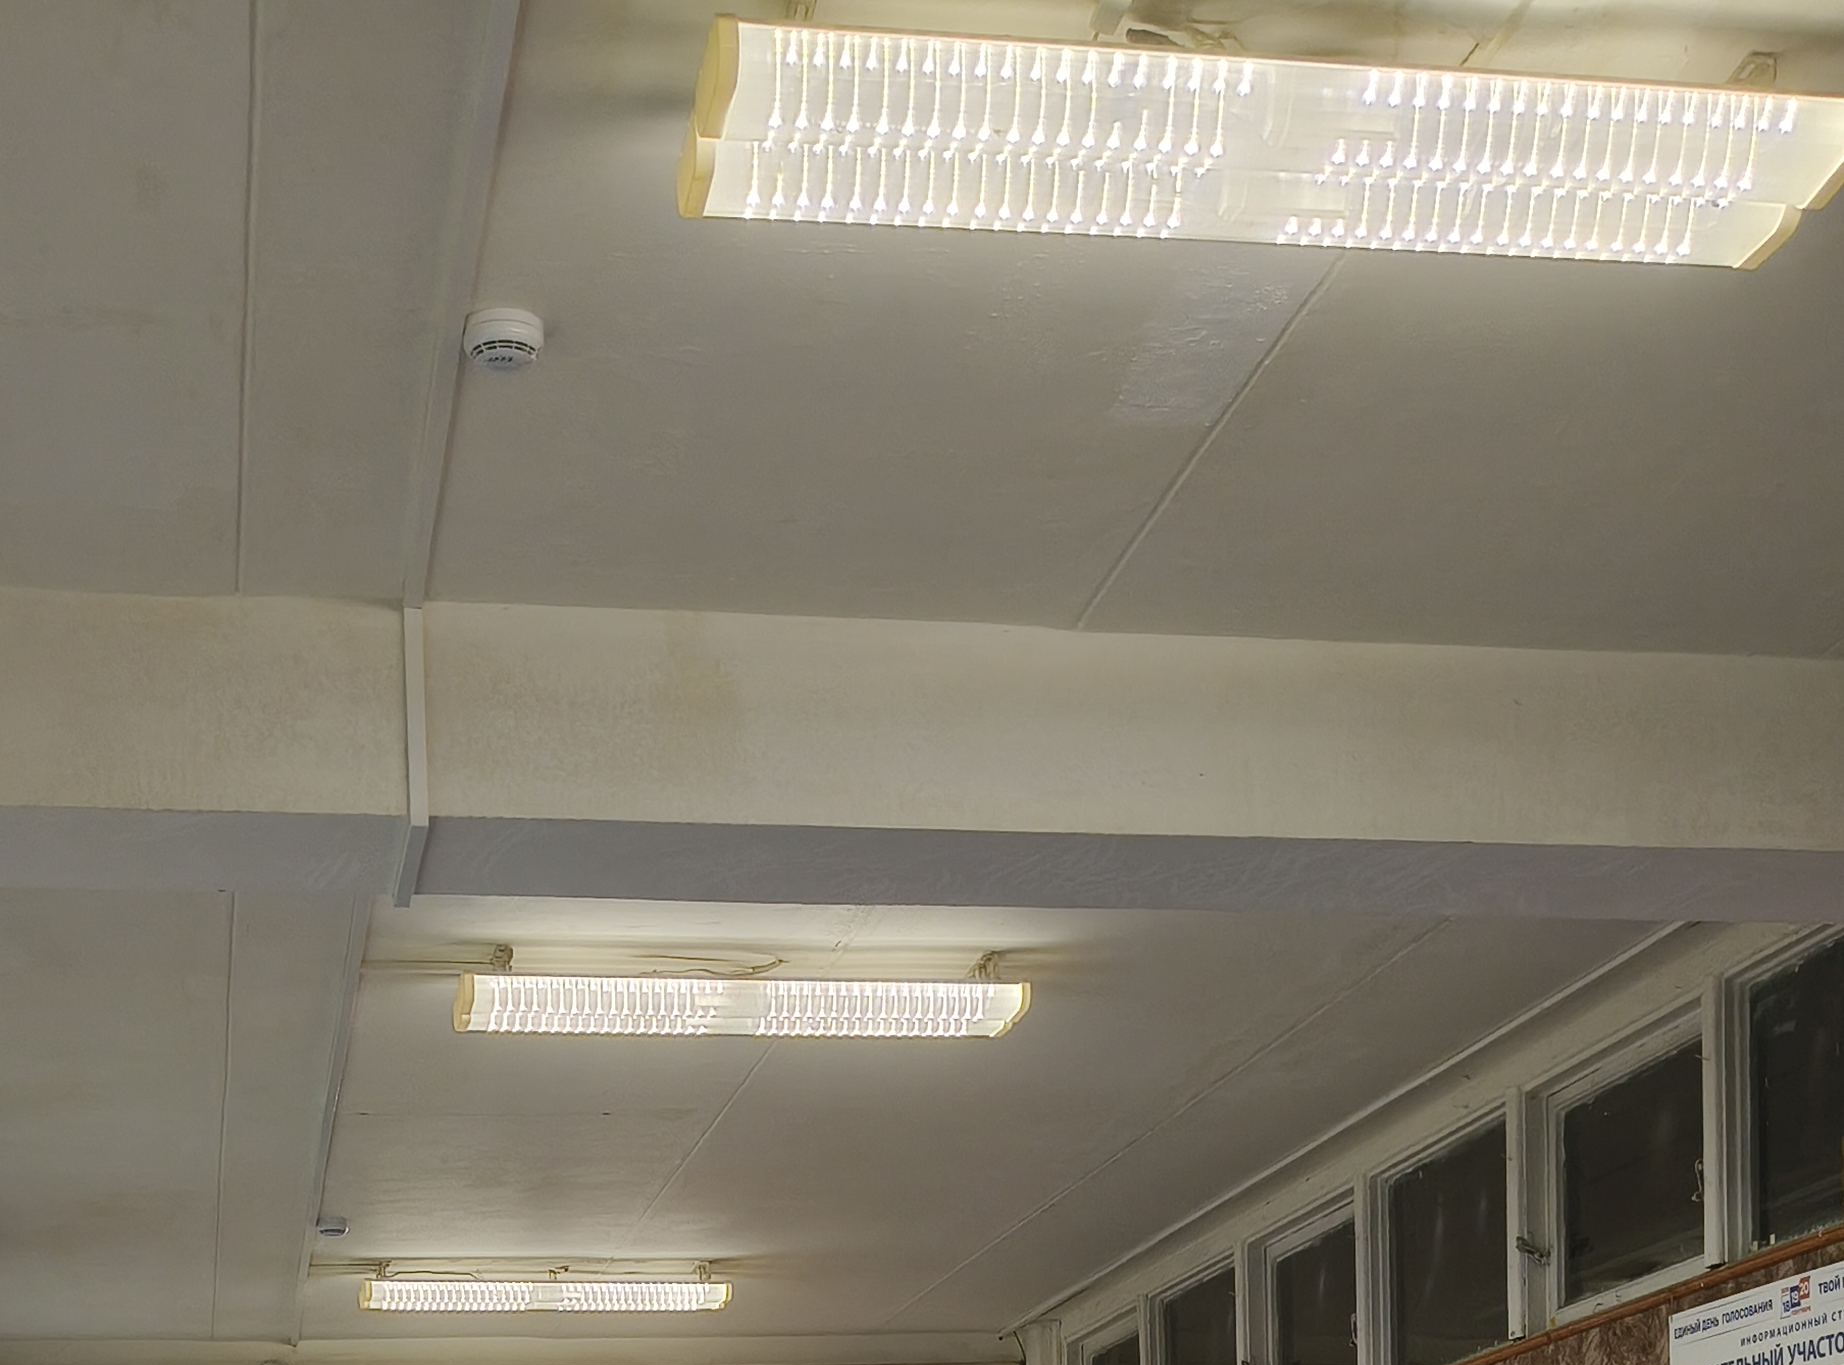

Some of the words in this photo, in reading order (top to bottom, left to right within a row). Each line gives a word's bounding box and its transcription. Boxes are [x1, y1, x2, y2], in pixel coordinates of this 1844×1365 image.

[1818, 1275, 1840, 1295] ТВОЙ
[1674, 1318, 1701, 1340] ЕДИНЫЙ
[1701, 1316, 1719, 1333] ДЕНЬ
[1721, 1299, 1773, 1326] ГОЛОСОВАНИЯ
[1740, 1312, 1828, 1347] ИНФОРМАЦИОННЫЙ
[1787, 1331, 1844, 1365] УЧАСТО
